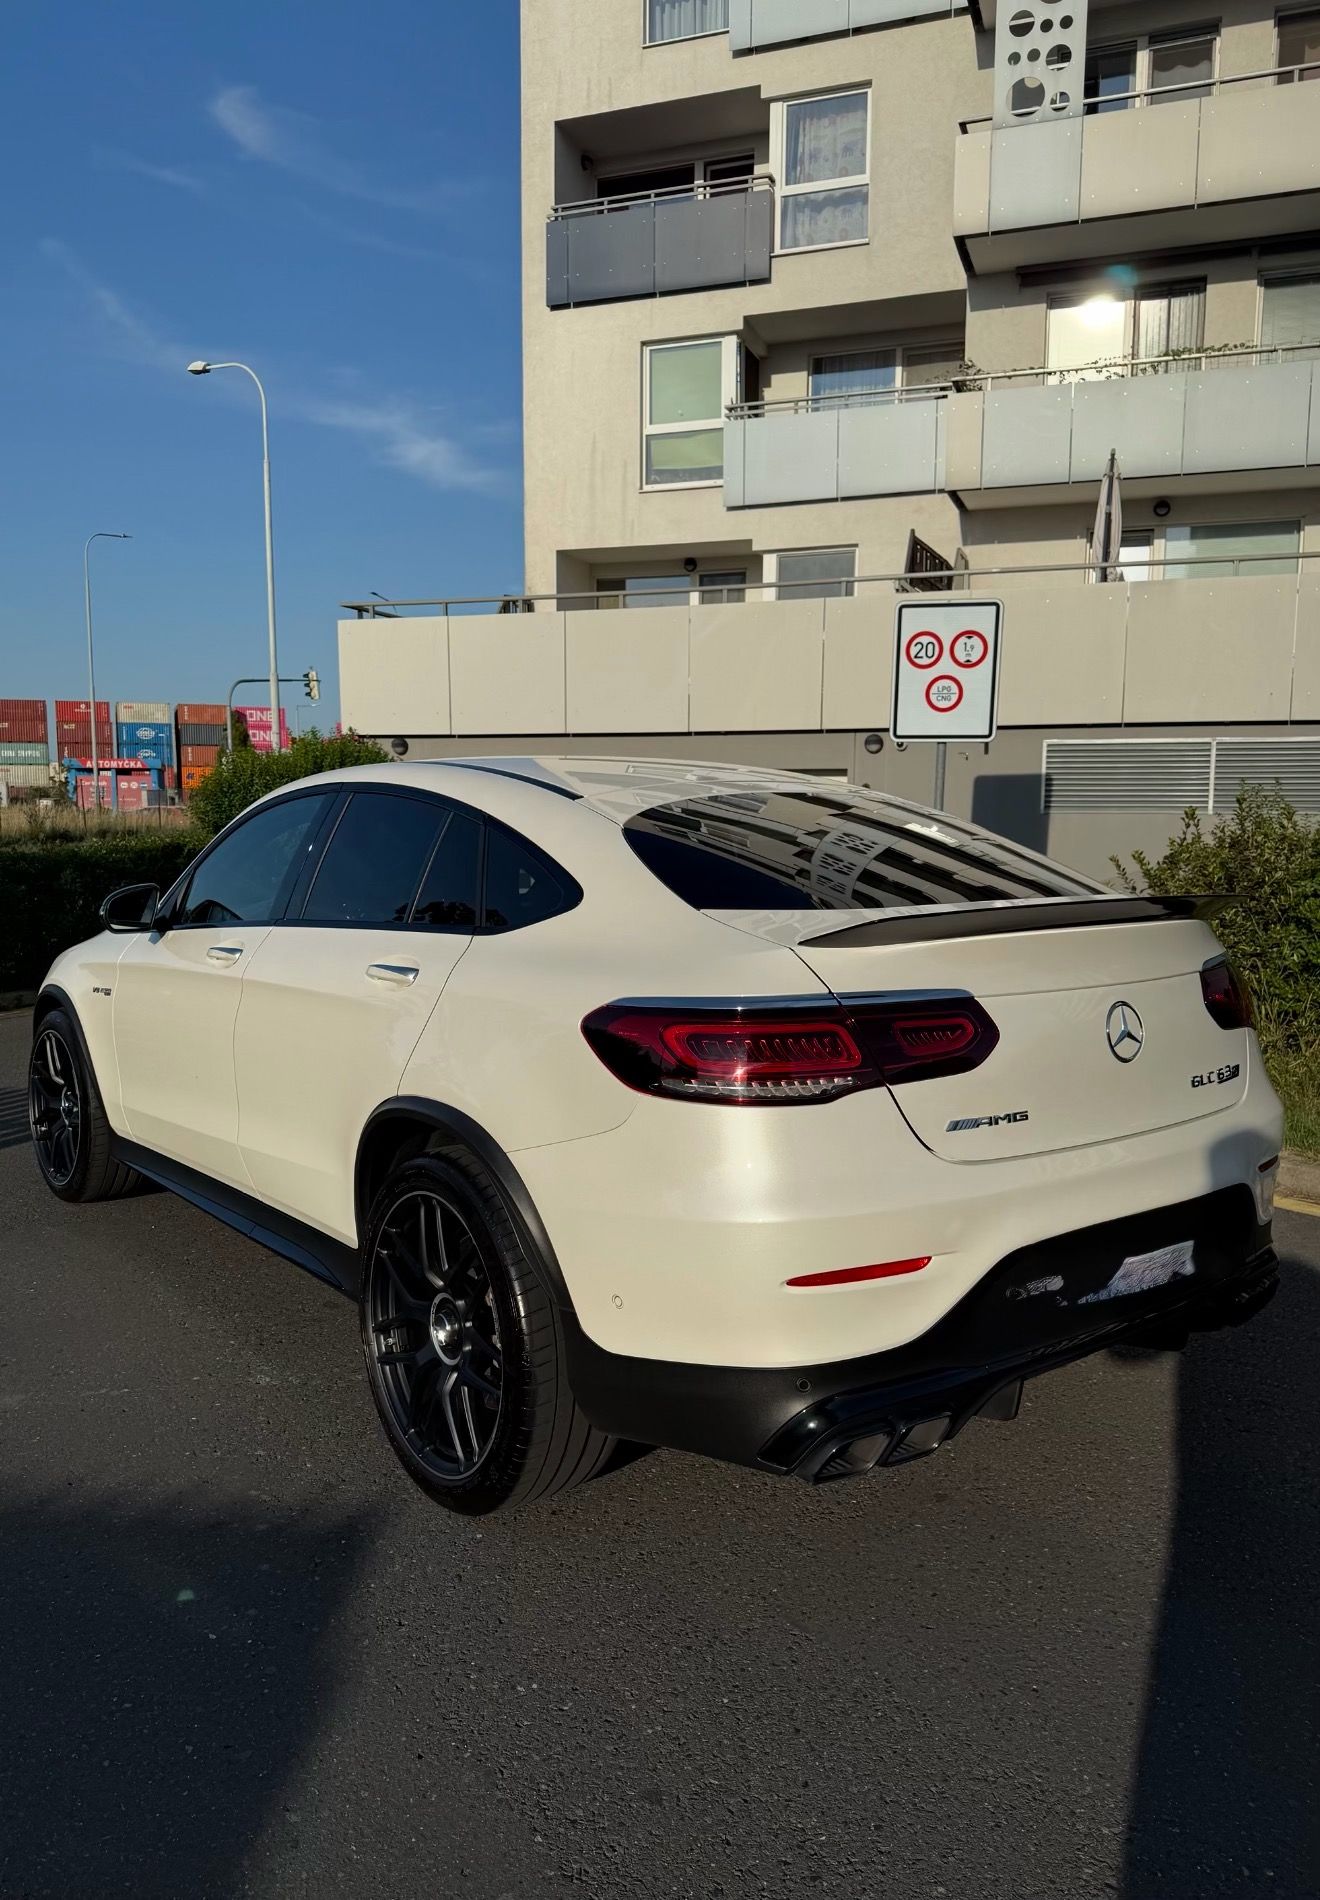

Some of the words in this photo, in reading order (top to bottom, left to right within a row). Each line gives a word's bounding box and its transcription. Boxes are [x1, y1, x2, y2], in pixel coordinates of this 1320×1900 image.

[913, 641, 936, 659] 20
[937, 685, 952, 693] LPG
[936, 694, 952, 702] CNG
[250, 729, 273, 741] ON
[1190, 1070, 1215, 1088] GLC
[976, 1109, 1029, 1128] AMG
